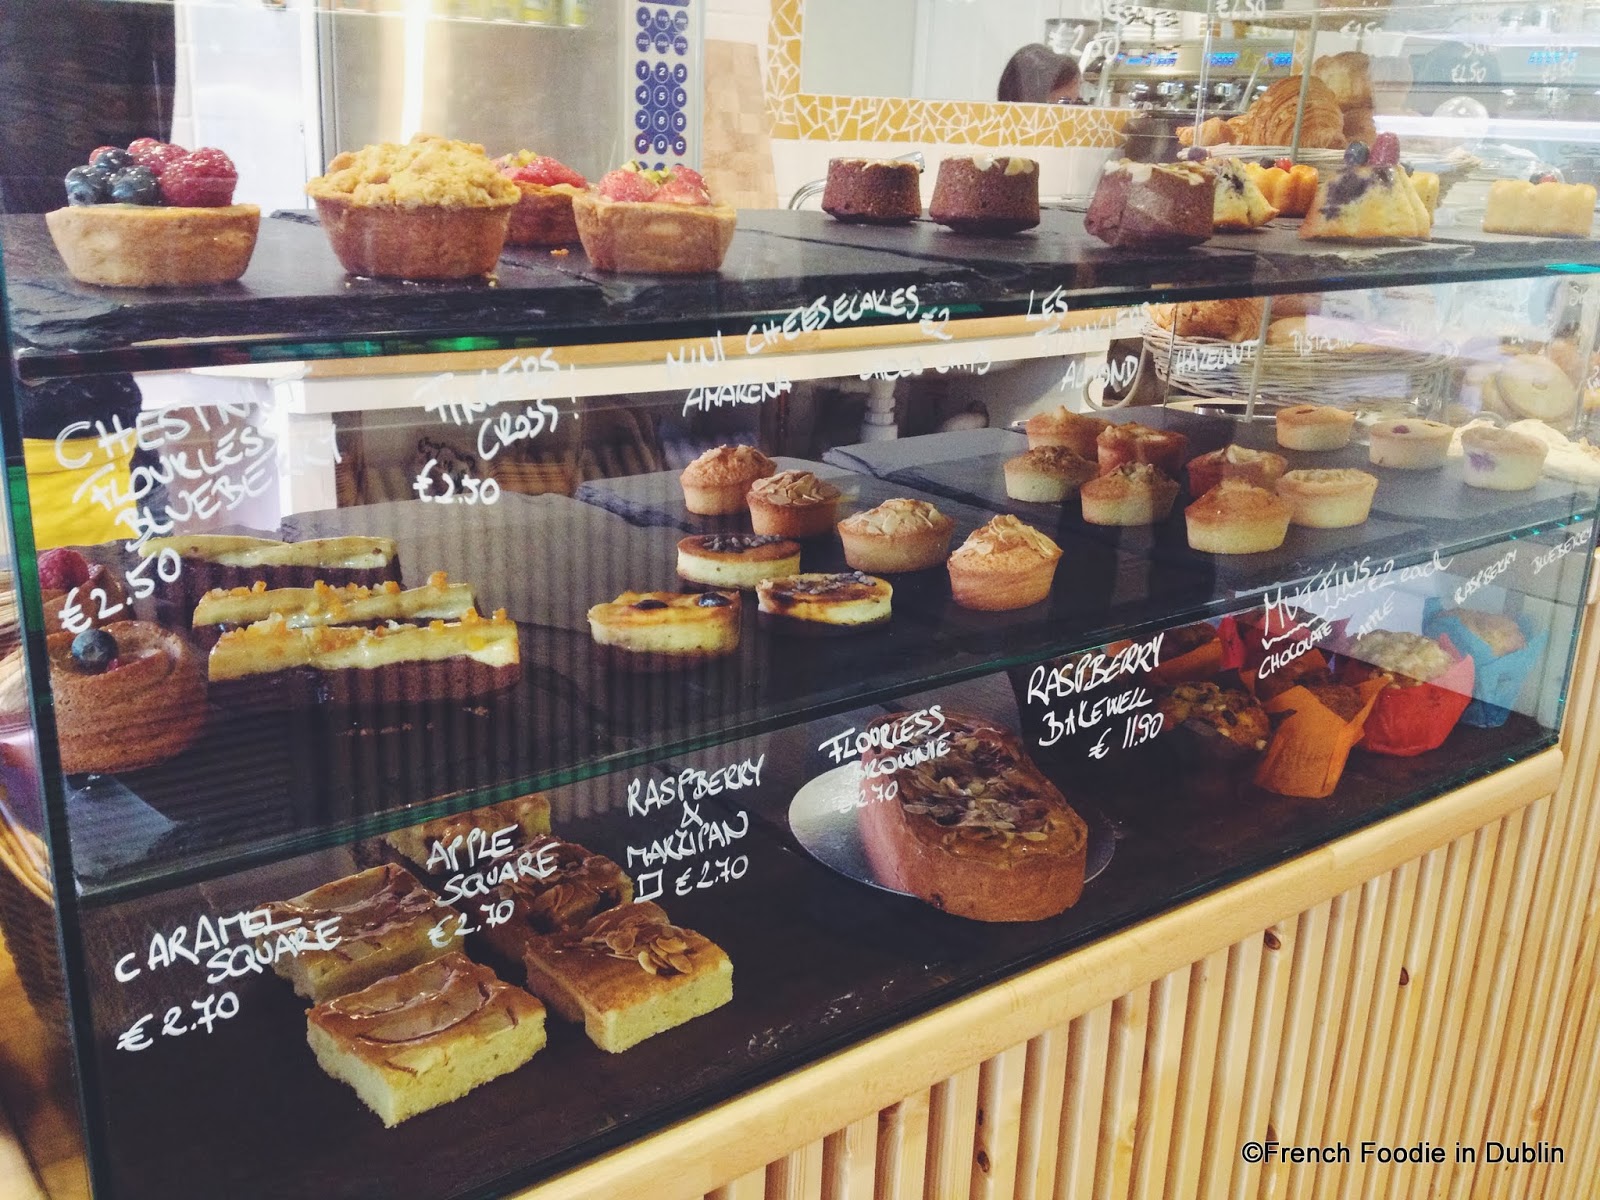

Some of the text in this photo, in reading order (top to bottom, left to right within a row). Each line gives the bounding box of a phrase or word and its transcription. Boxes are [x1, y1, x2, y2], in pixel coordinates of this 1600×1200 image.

[745, 285, 921, 354] CHEESECAKES
[1025, 284, 1069, 322] LES
[412, 458, 500, 505] €2.50
[57, 547, 182, 634] €2.50
[1026, 632, 1165, 704] RASPBERRY
[817, 705, 946, 764] FLOURLESS
[1037, 687, 1153, 747] BAKEWELL
[627, 753, 766, 817] RASPBERRY
[425, 824, 519, 873] APPLE
[626, 810, 750, 868] MARZIPAN
[436, 842, 562, 907] SQUARE
[114, 908, 303, 983] CARAMEL
[206, 915, 343, 984] SQUARE
